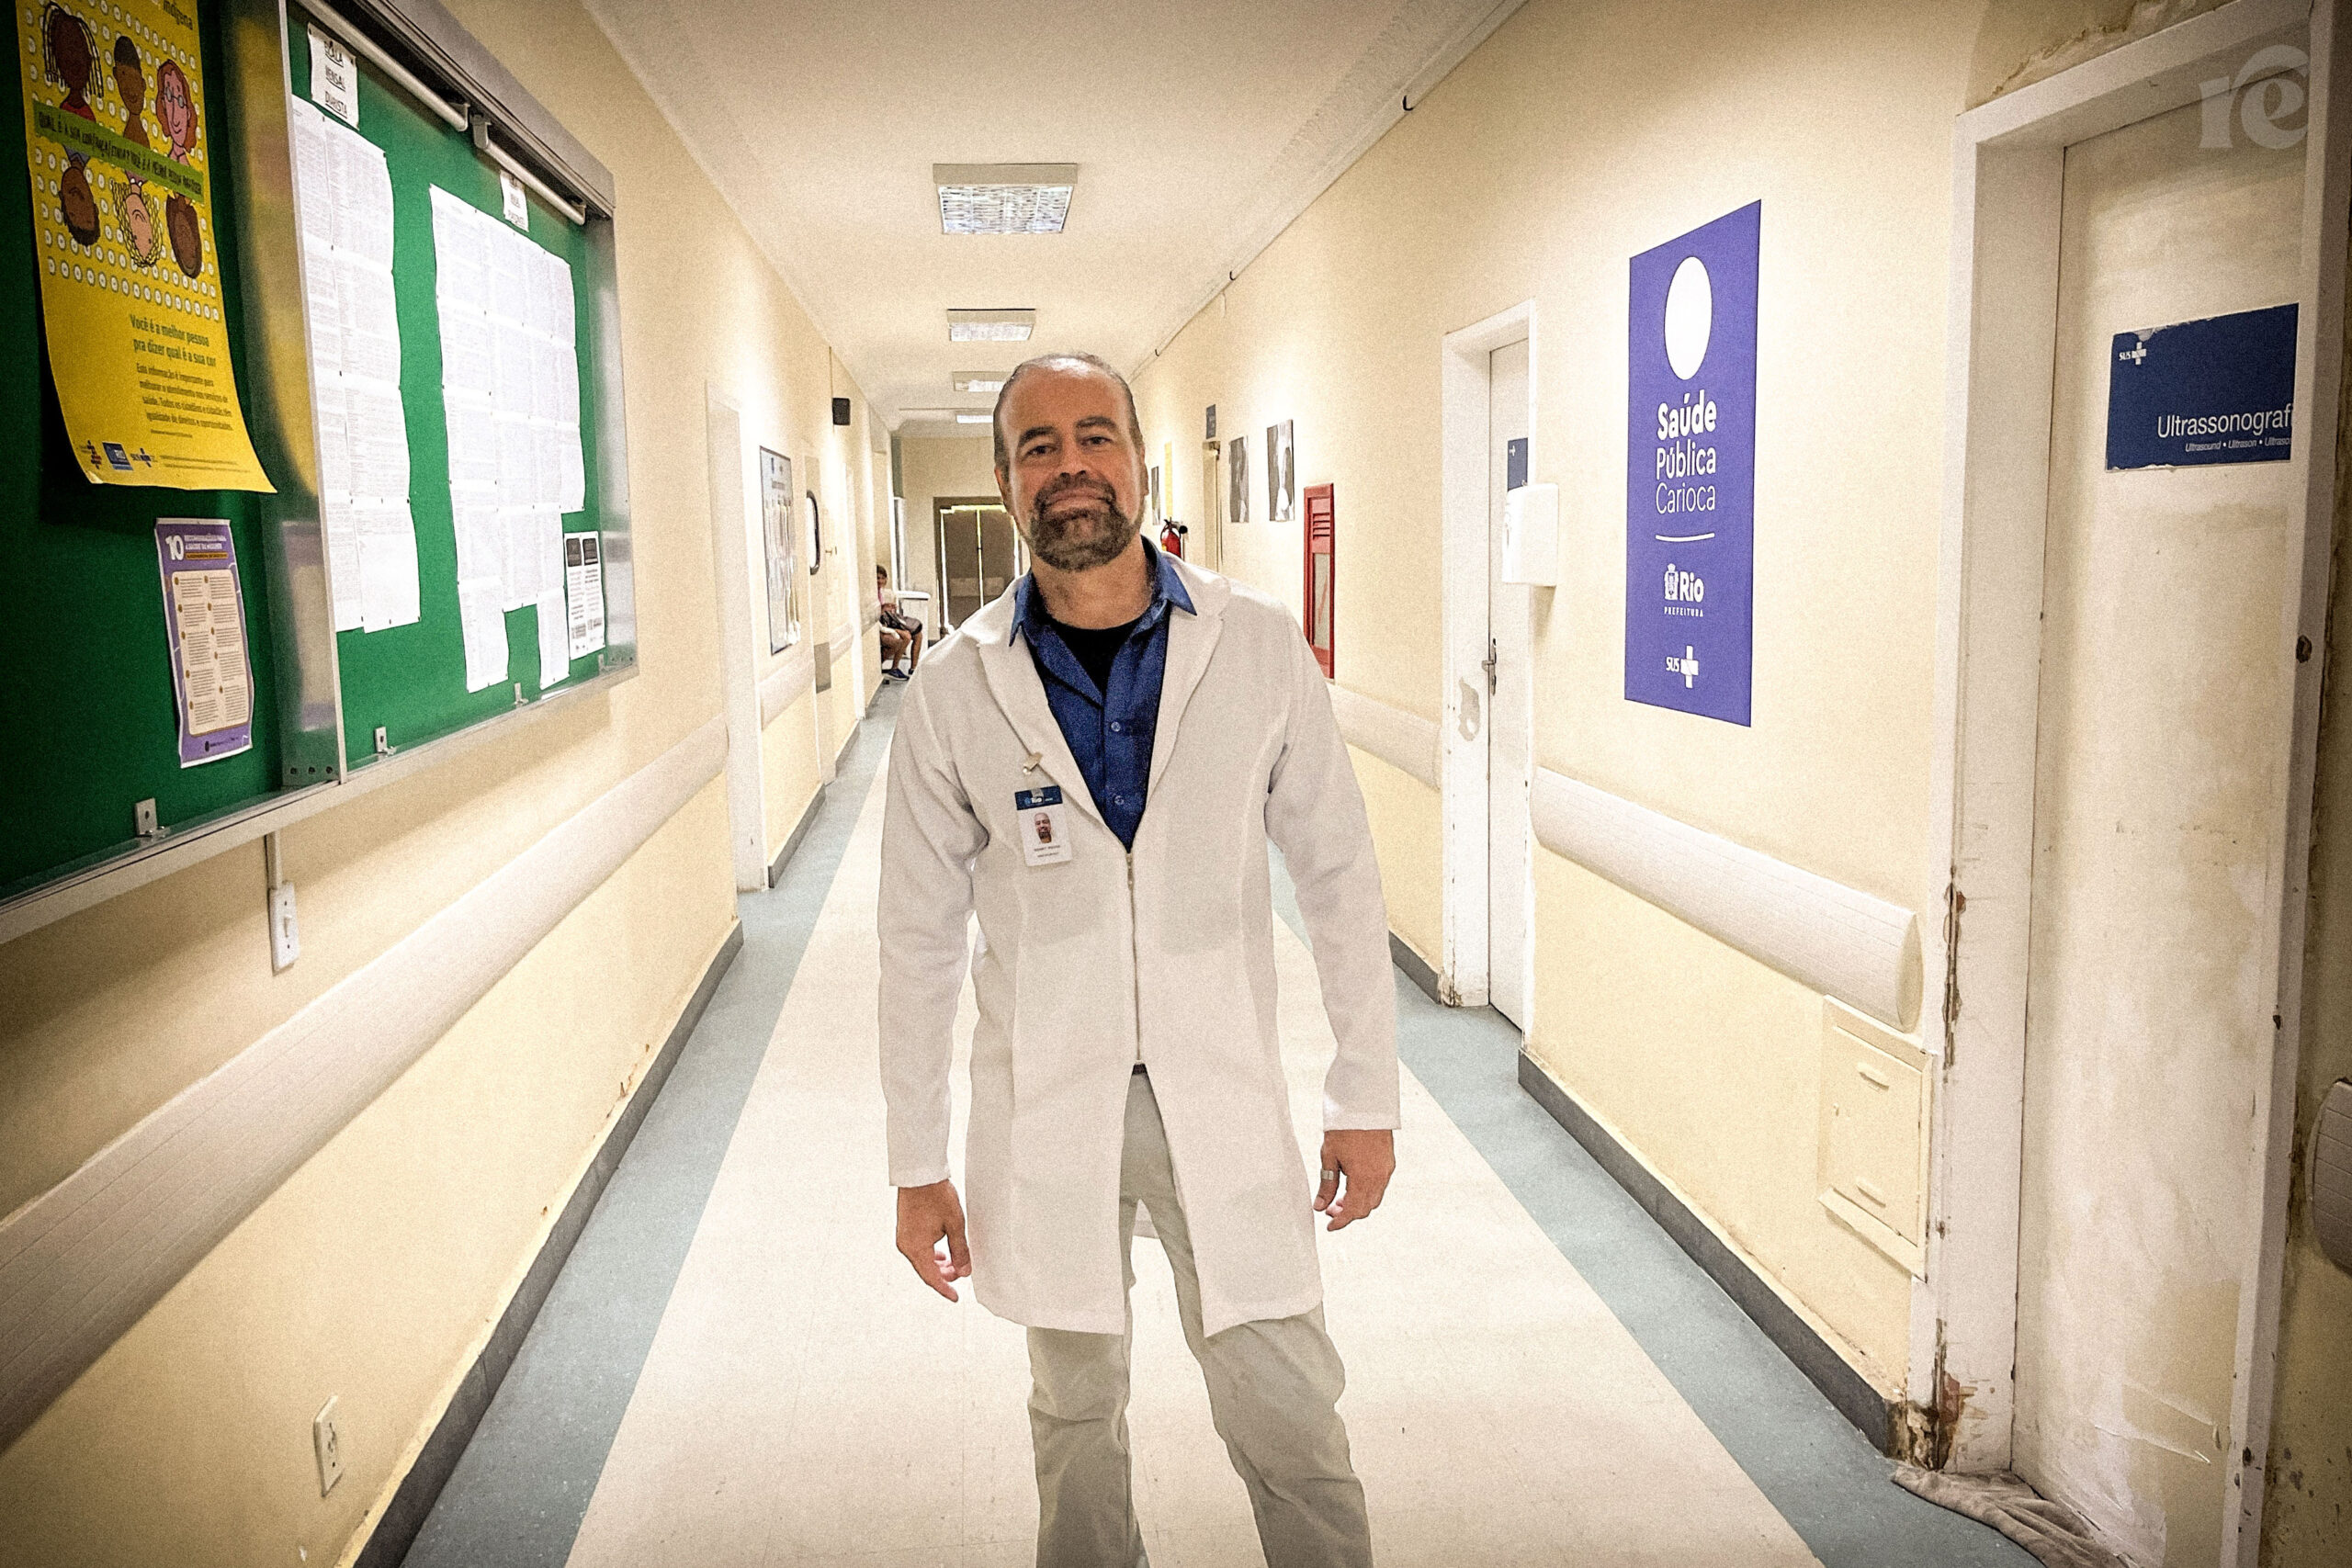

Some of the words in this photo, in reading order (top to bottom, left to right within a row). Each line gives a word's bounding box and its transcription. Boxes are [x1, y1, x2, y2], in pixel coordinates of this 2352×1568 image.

[130, 313, 149, 332] Você
[150, 319, 154, 333] é
[155, 323, 161, 334] a
[161, 324, 185, 340] melhor
[187, 332, 209, 347] pessoa
[133, 338, 146, 353] pra
[147, 339, 164, 355] dizer
[166, 345, 182, 361] qual
[183, 346, 187, 360] é
[187, 352, 193, 362] a
[193, 353, 205, 365] sua
[2119, 351, 2132, 361] SUS
[1657, 389, 1717, 441] Saúde
[2157, 403, 2292, 436] Ultrassonograf
[1657, 438, 1716, 480] Pública
[2185, 441, 2221, 453] Ultrasound
[1656, 482, 1715, 514] Carioca
[165, 535, 184, 560] 10
[1679, 571, 1704, 603] Rio
[1664, 606, 1703, 617] PREFEITURA
[1666, 656, 1679, 672] SUS
